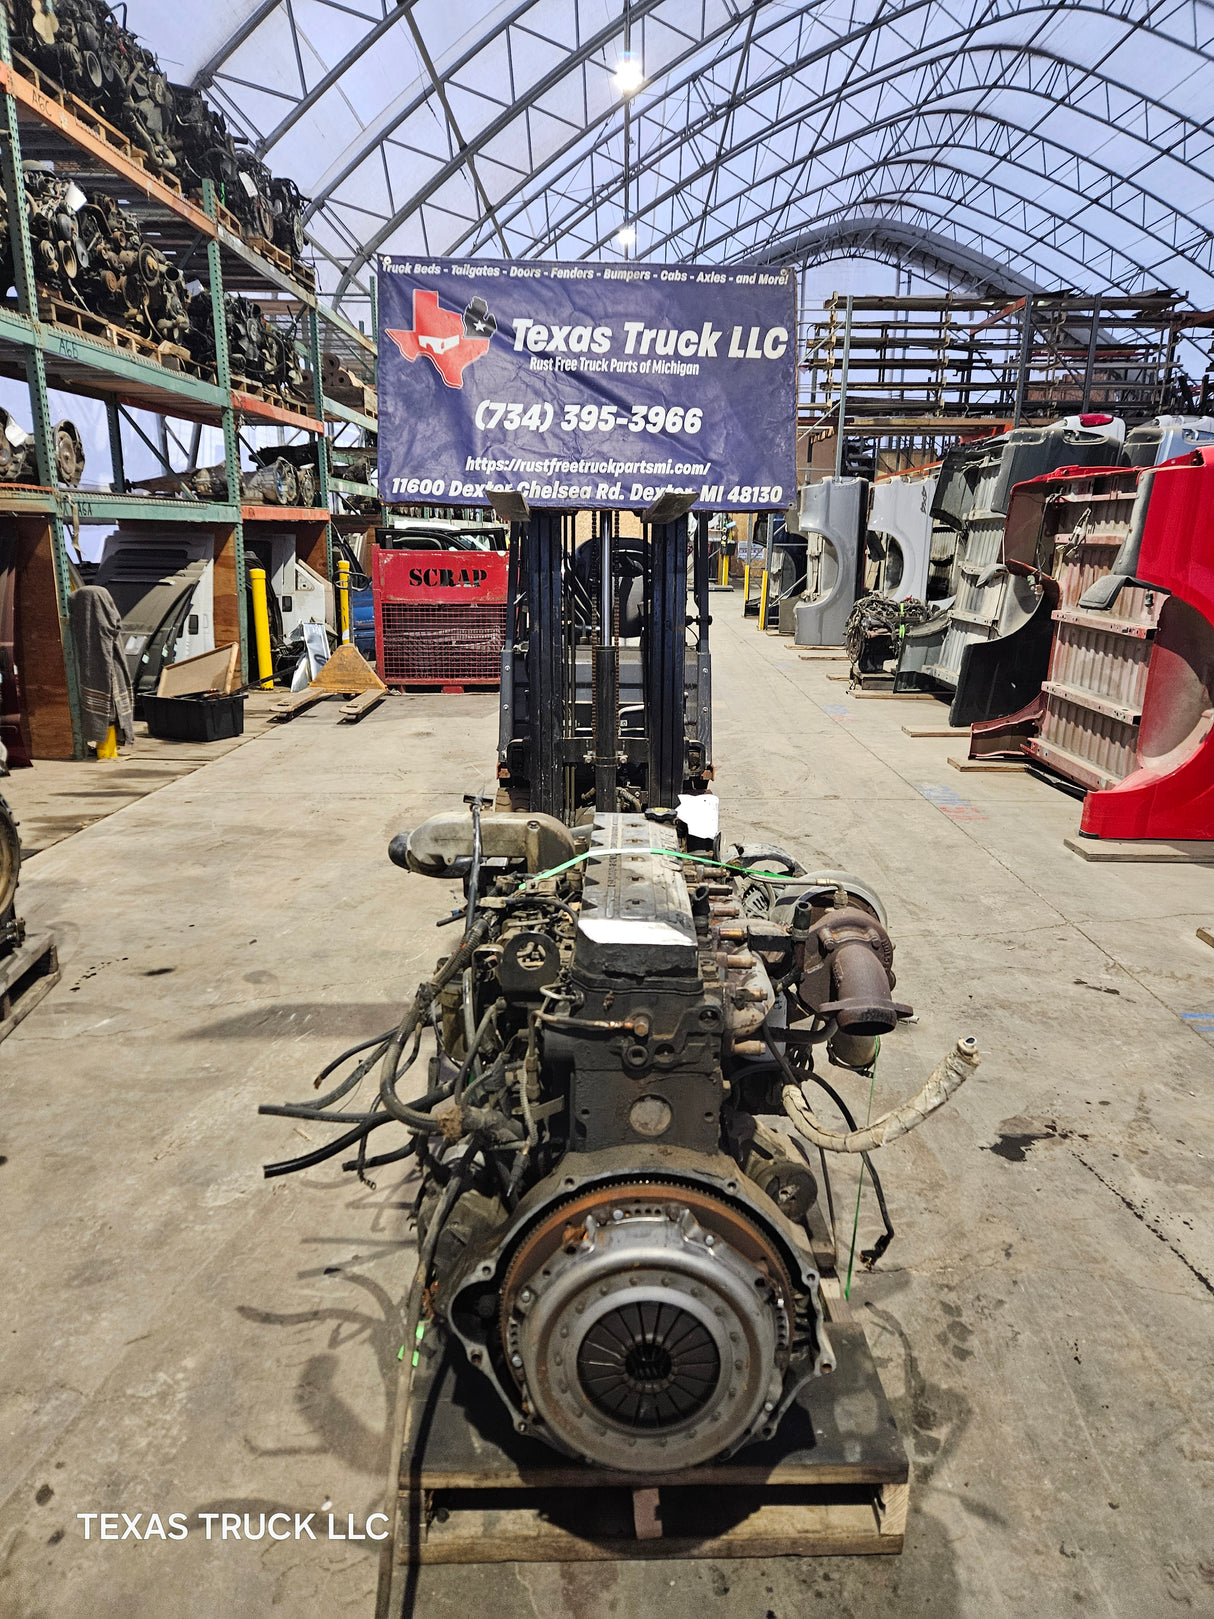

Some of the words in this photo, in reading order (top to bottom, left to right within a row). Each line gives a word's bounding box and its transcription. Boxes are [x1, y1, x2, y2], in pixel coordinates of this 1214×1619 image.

[381, 261, 412, 275] Truck
[413, 263, 441, 275] Beds
[451, 264, 500, 279] Tailgates
[510, 266, 541, 278] Doors
[551, 267, 594, 279] Fenders
[604, 269, 650, 282] Bumpers
[661, 270, 687, 281] Cabs
[696, 271, 726, 283] Axles
[736, 273, 756, 285] and
[758, 274, 789, 285] More!
[512, 318, 613, 354] Texas
[623, 321, 722, 357] Truck
[728, 326, 789, 359] LLC
[530, 357, 554, 371] Rust
[554, 356, 577, 371] Free
[579, 357, 609, 372] Truck
[610, 358, 638, 373] Parts
[639, 359, 651, 373] of
[652, 360, 700, 376] Michigan
[475, 400, 554, 433] (734)
[560, 403, 704, 434] 395-3966
[465, 456, 711, 476] https://rustfreetruckpartsmi.com/
[392, 477, 445, 496] 11600
[516, 481, 592, 500] Chelsea
[596, 482, 625, 501] Rd.
[700, 485, 724, 503] MI
[727, 486, 783, 504] 48130
[408, 568, 488, 588] SCRAP
